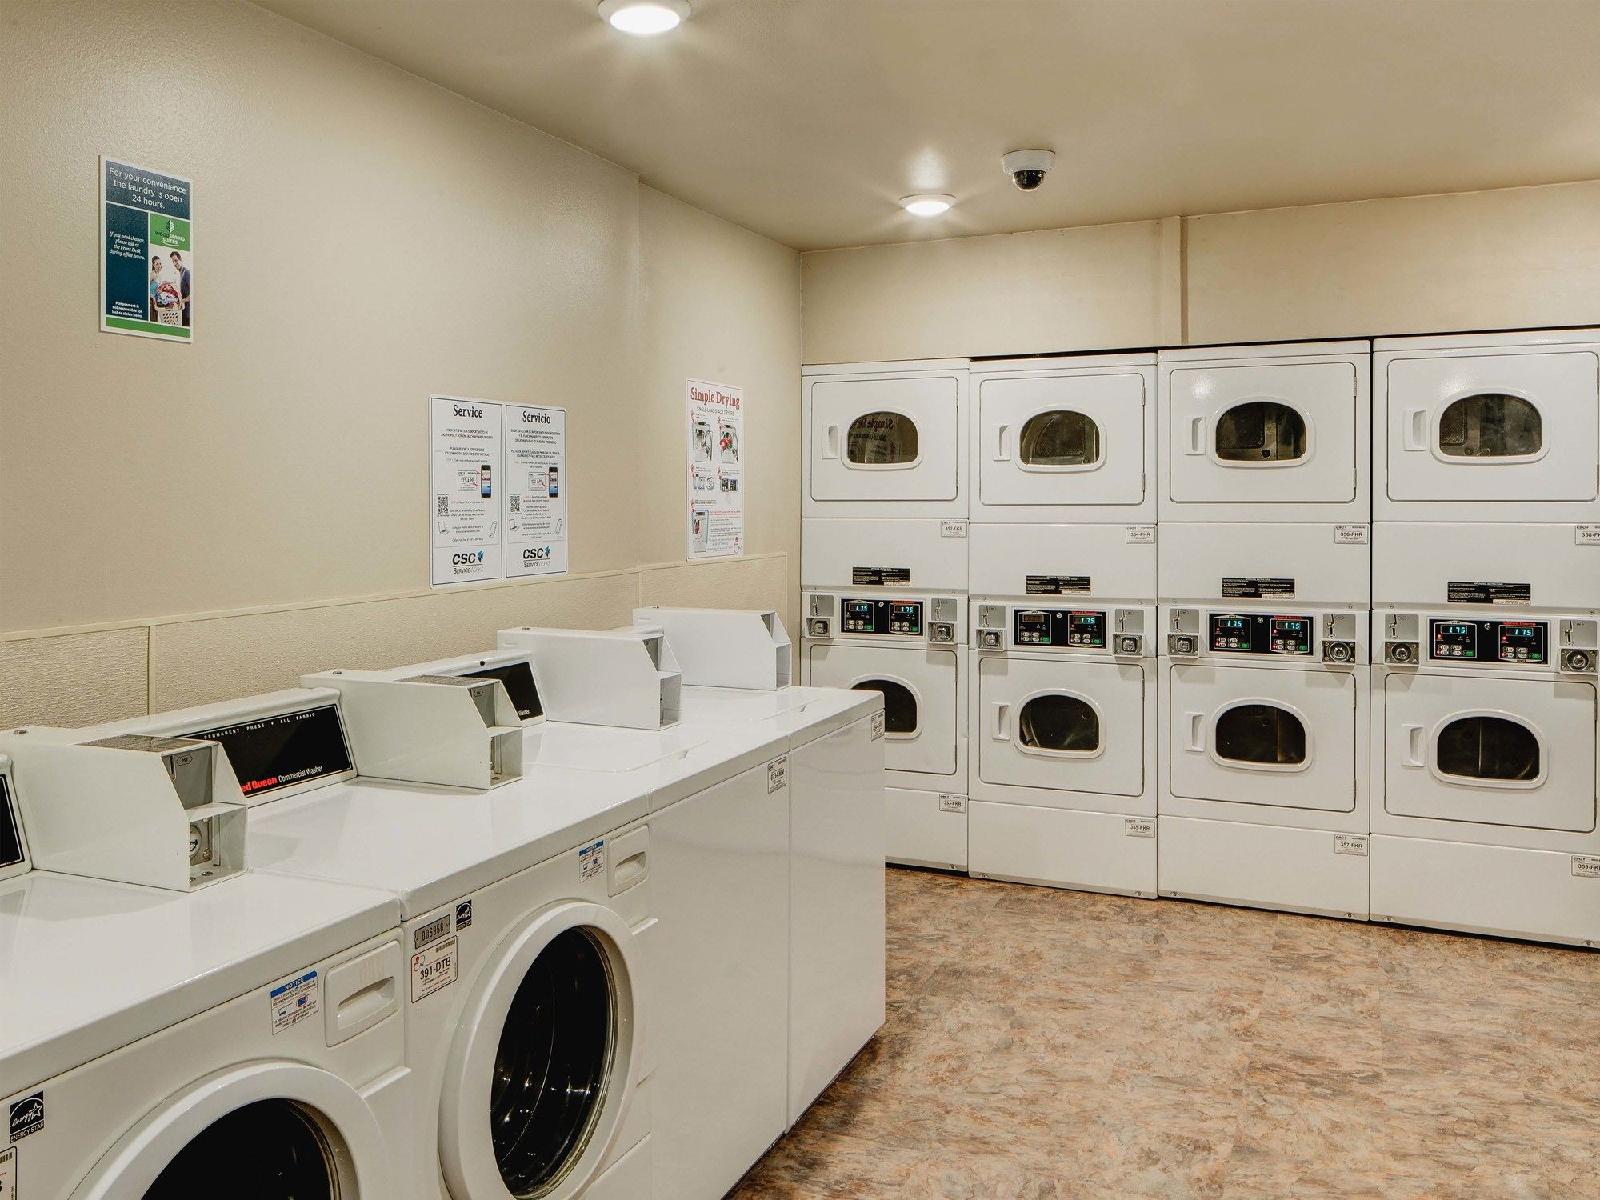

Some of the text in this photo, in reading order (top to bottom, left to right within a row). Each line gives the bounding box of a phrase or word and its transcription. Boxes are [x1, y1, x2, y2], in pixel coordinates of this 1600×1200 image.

[109, 167, 187, 194] For your convenience
[128, 182, 155, 197] laundry
[132, 194, 142, 203] 24
[690, 386, 740, 410] Simple Drying
[453, 404, 483, 419] Service
[522, 410, 551, 424] Servicio
[452, 552, 476, 565] CSC
[522, 548, 544, 559] CSC
[252, 776, 278, 789] Queen
[278, 769, 306, 783] Commercial
